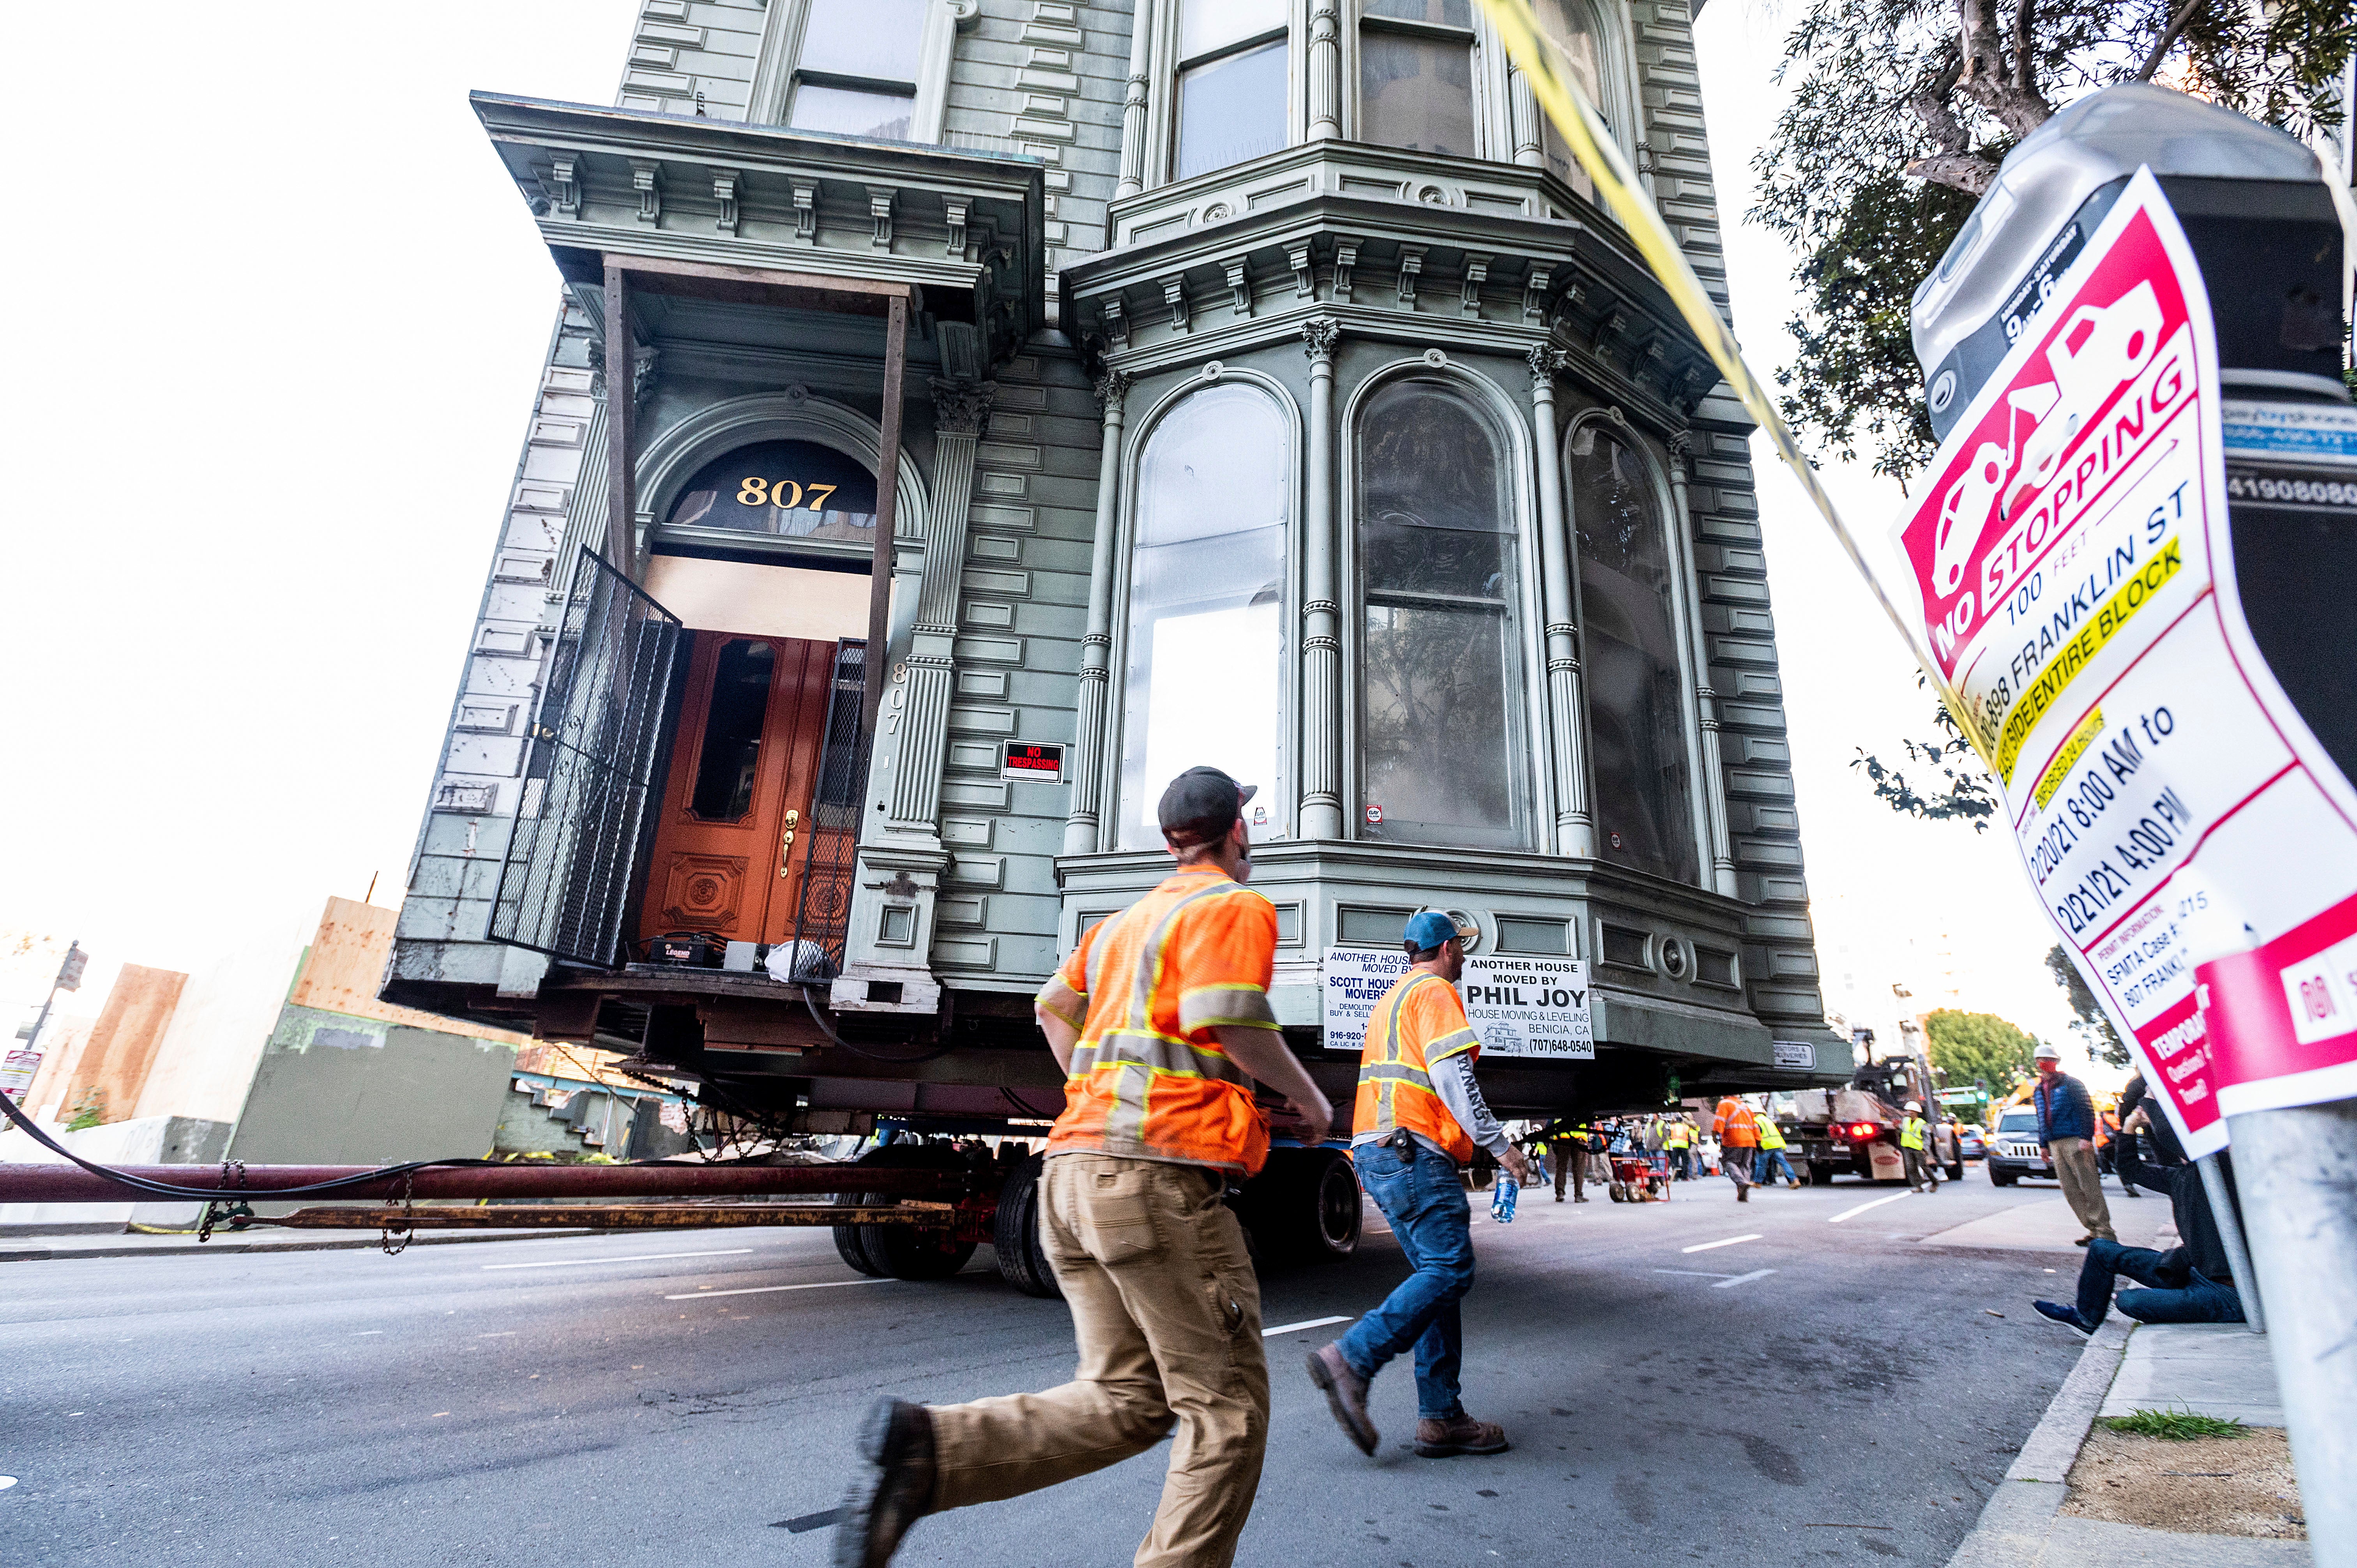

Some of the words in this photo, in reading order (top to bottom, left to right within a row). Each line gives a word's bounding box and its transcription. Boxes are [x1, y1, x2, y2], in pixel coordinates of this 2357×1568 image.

[736, 477, 838, 511] 807
[1935, 591, 1974, 662] NO
[1989, 355, 2182, 600] STOPPING
[2007, 572, 2042, 626] 100
[2053, 531, 2088, 577] FEET
[2011, 534, 2134, 690] FRANKLIN
[2147, 480, 2188, 544] ST
[2007, 629, 2095, 750] SIDE/ENTIRE
[2099, 542, 2182, 639] BLOCK
[1027, 746, 1041, 757] NO
[1008, 756, 1058, 770] TRESPASSING
[2035, 756, 2068, 809] ENFORCED
[2031, 813, 2078, 886] 2/20/21
[2068, 771, 2115, 828] 8:00
[2102, 727, 2143, 785] AM
[2141, 707, 2173, 745] to
[2057, 861, 2131, 934] 2/21/21
[2115, 818, 2173, 870] 4:00
[1330, 952, 1376, 963] ANOTHER
[1470, 960, 1531, 971] ANOTHER
[1535, 962, 1578, 973] HOUSE
[2108, 950, 2145, 985] SFMTA
[2143, 932, 2170, 958] Case
[1362, 964, 1397, 973] MOVED
[1330, 976, 1363, 988] SCOTT
[1368, 978, 1398, 989] HOUS
[1493, 975, 1537, 985] MOVED
[1542, 976, 1558, 985] BY
[1467, 986, 1527, 1006] PHIL
[1536, 989, 1586, 1008] JOY
[1468, 1009, 1500, 1019] HOUSE
[1502, 1010, 1537, 1020] MOVING
[1539, 1012, 1545, 1021] &
[1547, 1012, 1589, 1022] LEVELING
[1529, 1024, 1572, 1036] BENICIA,
[1575, 1026, 1589, 1035] CA
[1530, 1039, 1592, 1054] (707)648-0540
